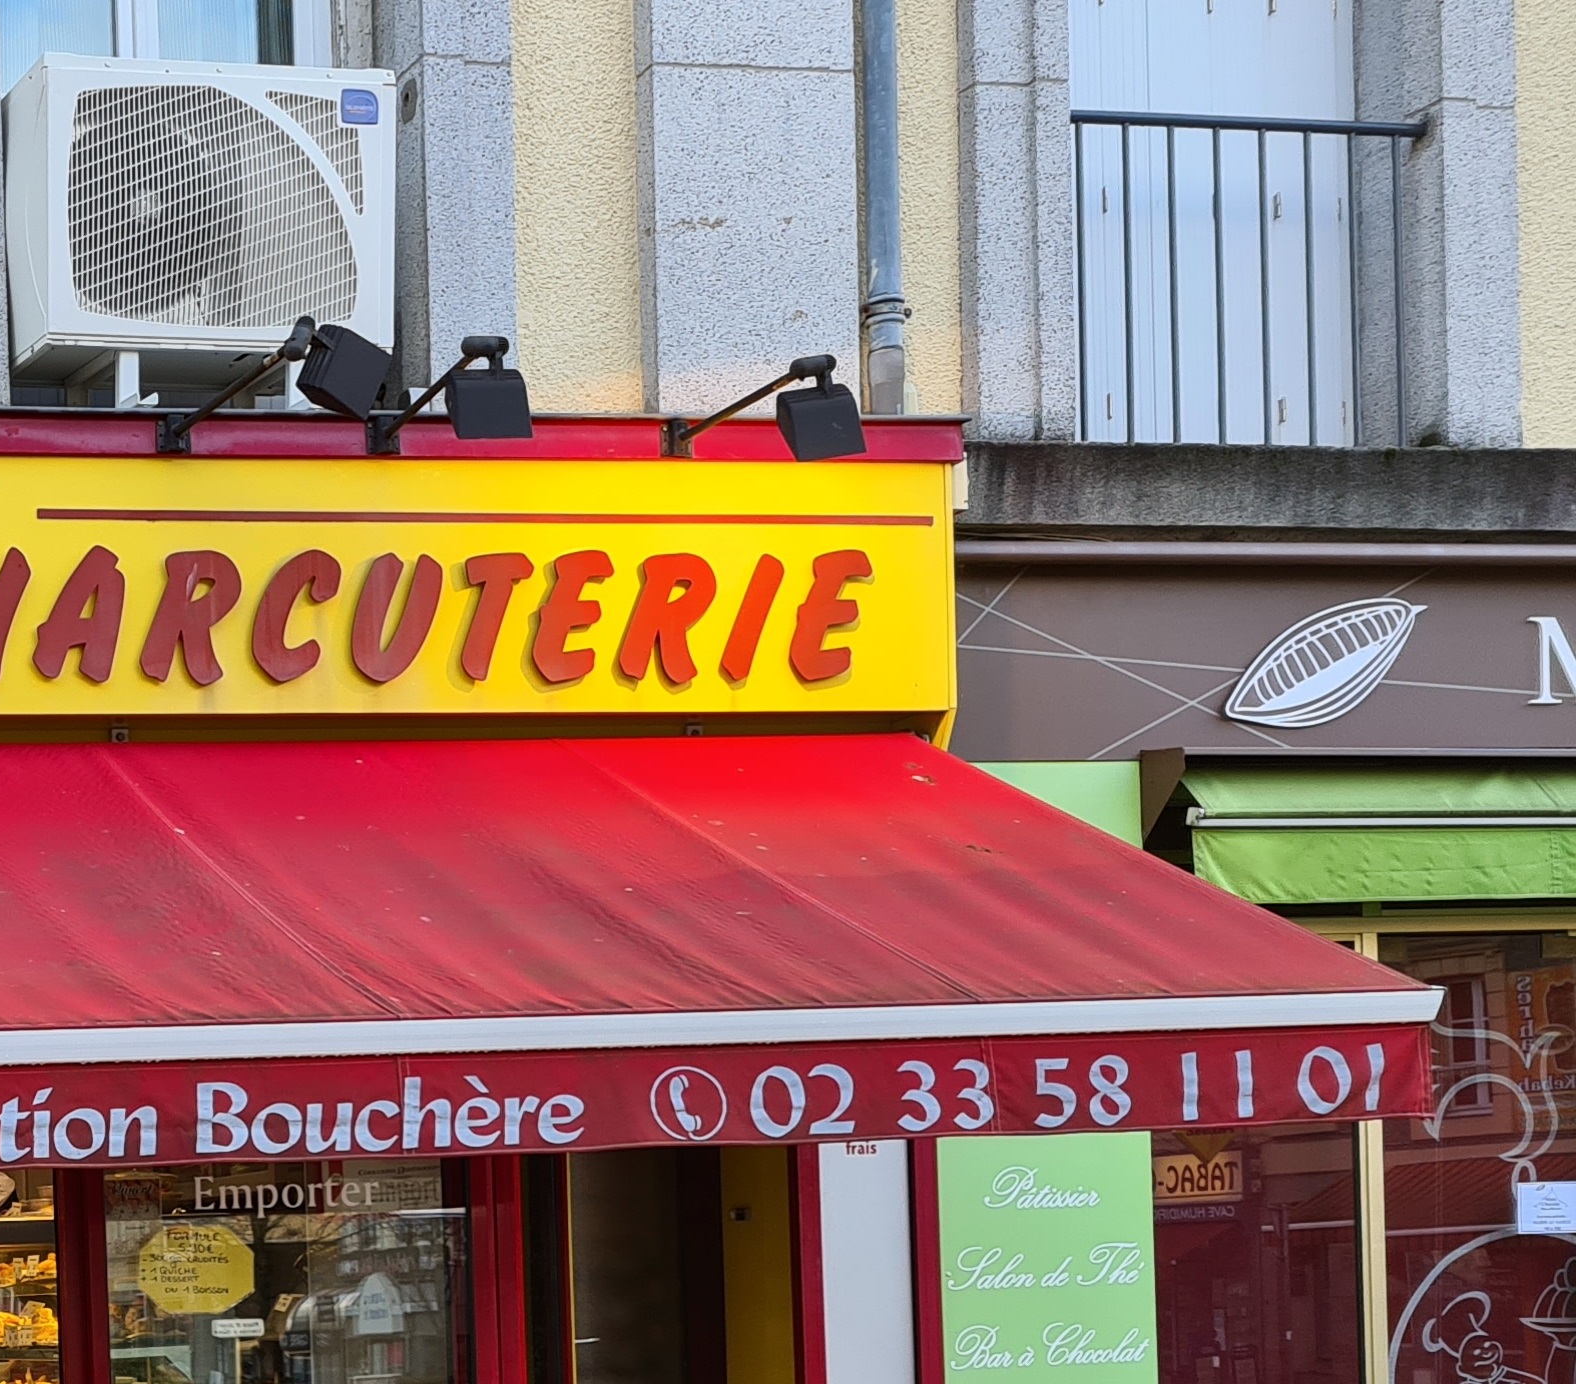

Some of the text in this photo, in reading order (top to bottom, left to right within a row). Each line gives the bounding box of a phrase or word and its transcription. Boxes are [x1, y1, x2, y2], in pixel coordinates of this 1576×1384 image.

[194, 1075, 585, 1156] Bouchère
[750, 1063, 856, 1138] 02
[896, 1058, 995, 1131] 33
[1034, 1055, 1132, 1128] 58
[1181, 1049, 1253, 1122] 11
[1296, 1043, 1385, 1115] 01
[845, 1140, 877, 1155] frais
[193, 1174, 379, 1219] Emporter
[984, 1166, 1100, 1209] Pâtissier
[948, 1242, 1145, 1291] Salon de Thé
[951, 1322, 1150, 1370] Bar à Chocolat
